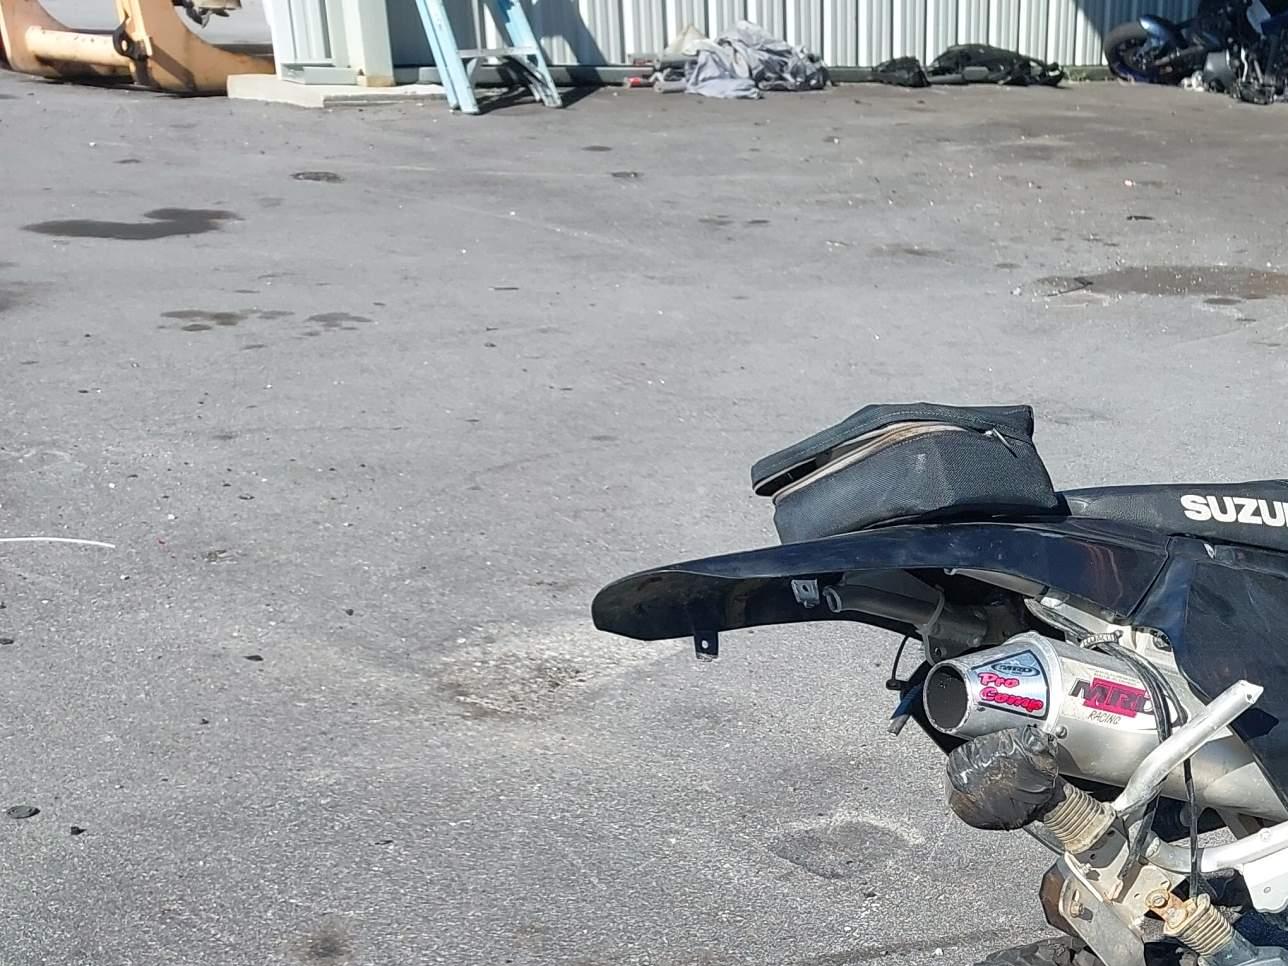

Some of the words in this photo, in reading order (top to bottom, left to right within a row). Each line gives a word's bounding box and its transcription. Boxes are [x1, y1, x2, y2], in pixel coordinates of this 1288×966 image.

[978, 672, 1020, 688] Pro
[979, 686, 1044, 712] Comp
[1088, 710, 1121, 724] RACING
